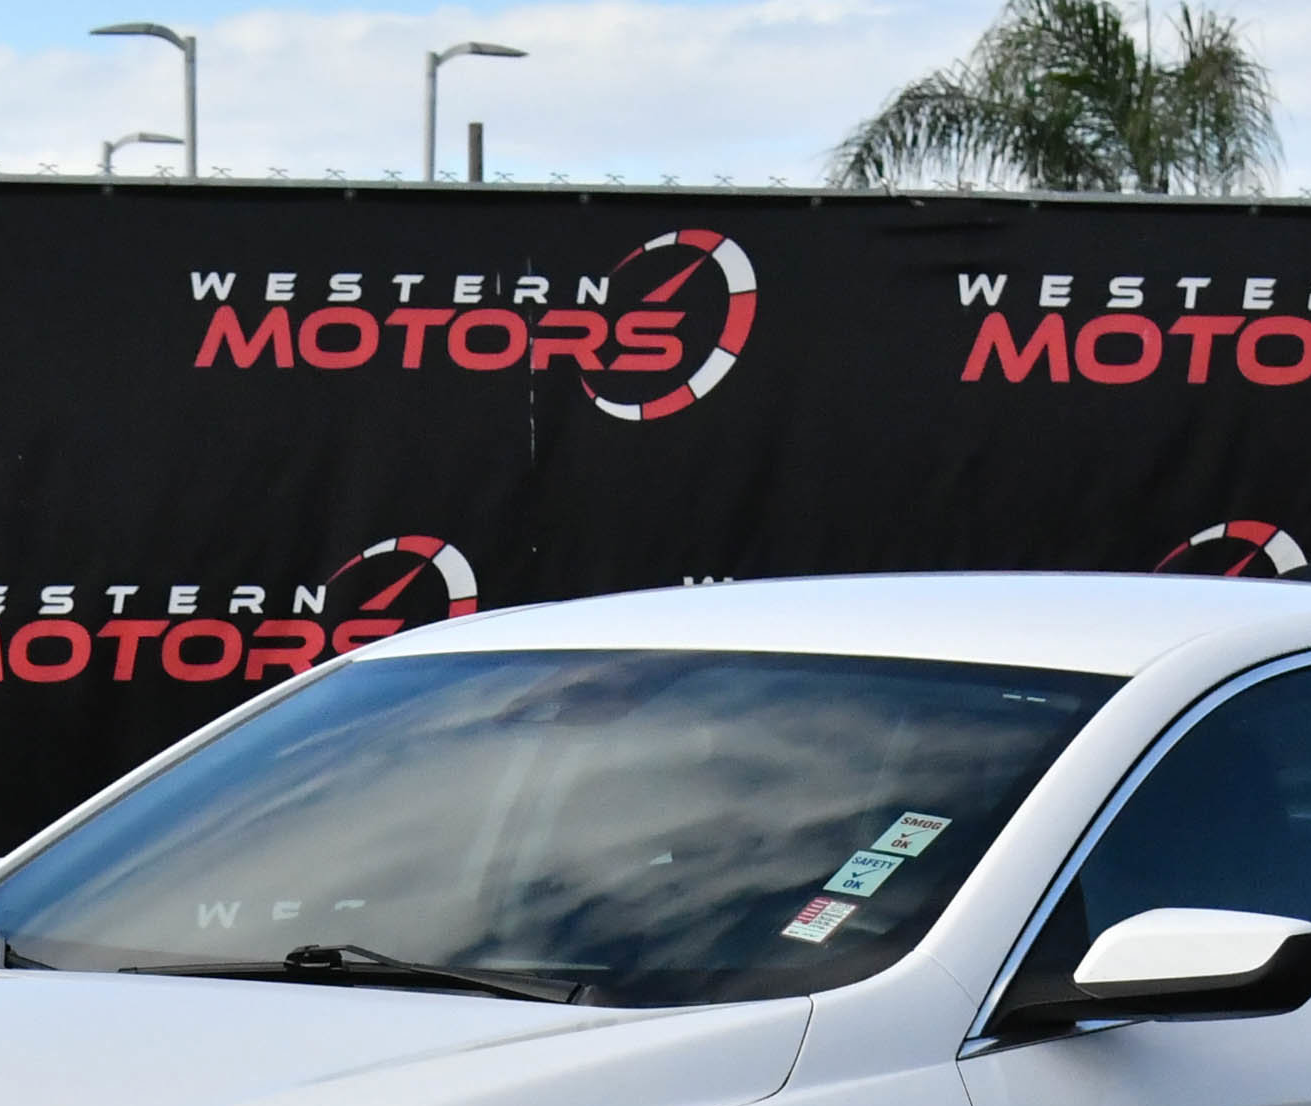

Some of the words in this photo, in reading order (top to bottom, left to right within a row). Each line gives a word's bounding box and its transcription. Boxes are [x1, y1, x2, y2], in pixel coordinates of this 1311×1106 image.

[191, 271, 610, 304] WESTERN
[193, 304, 686, 372] MOTORS
[900, 816, 943, 831] SMOG
[891, 839, 912, 850] OK
[851, 856, 896, 870] SAFETY
[843, 879, 865, 890] OK
